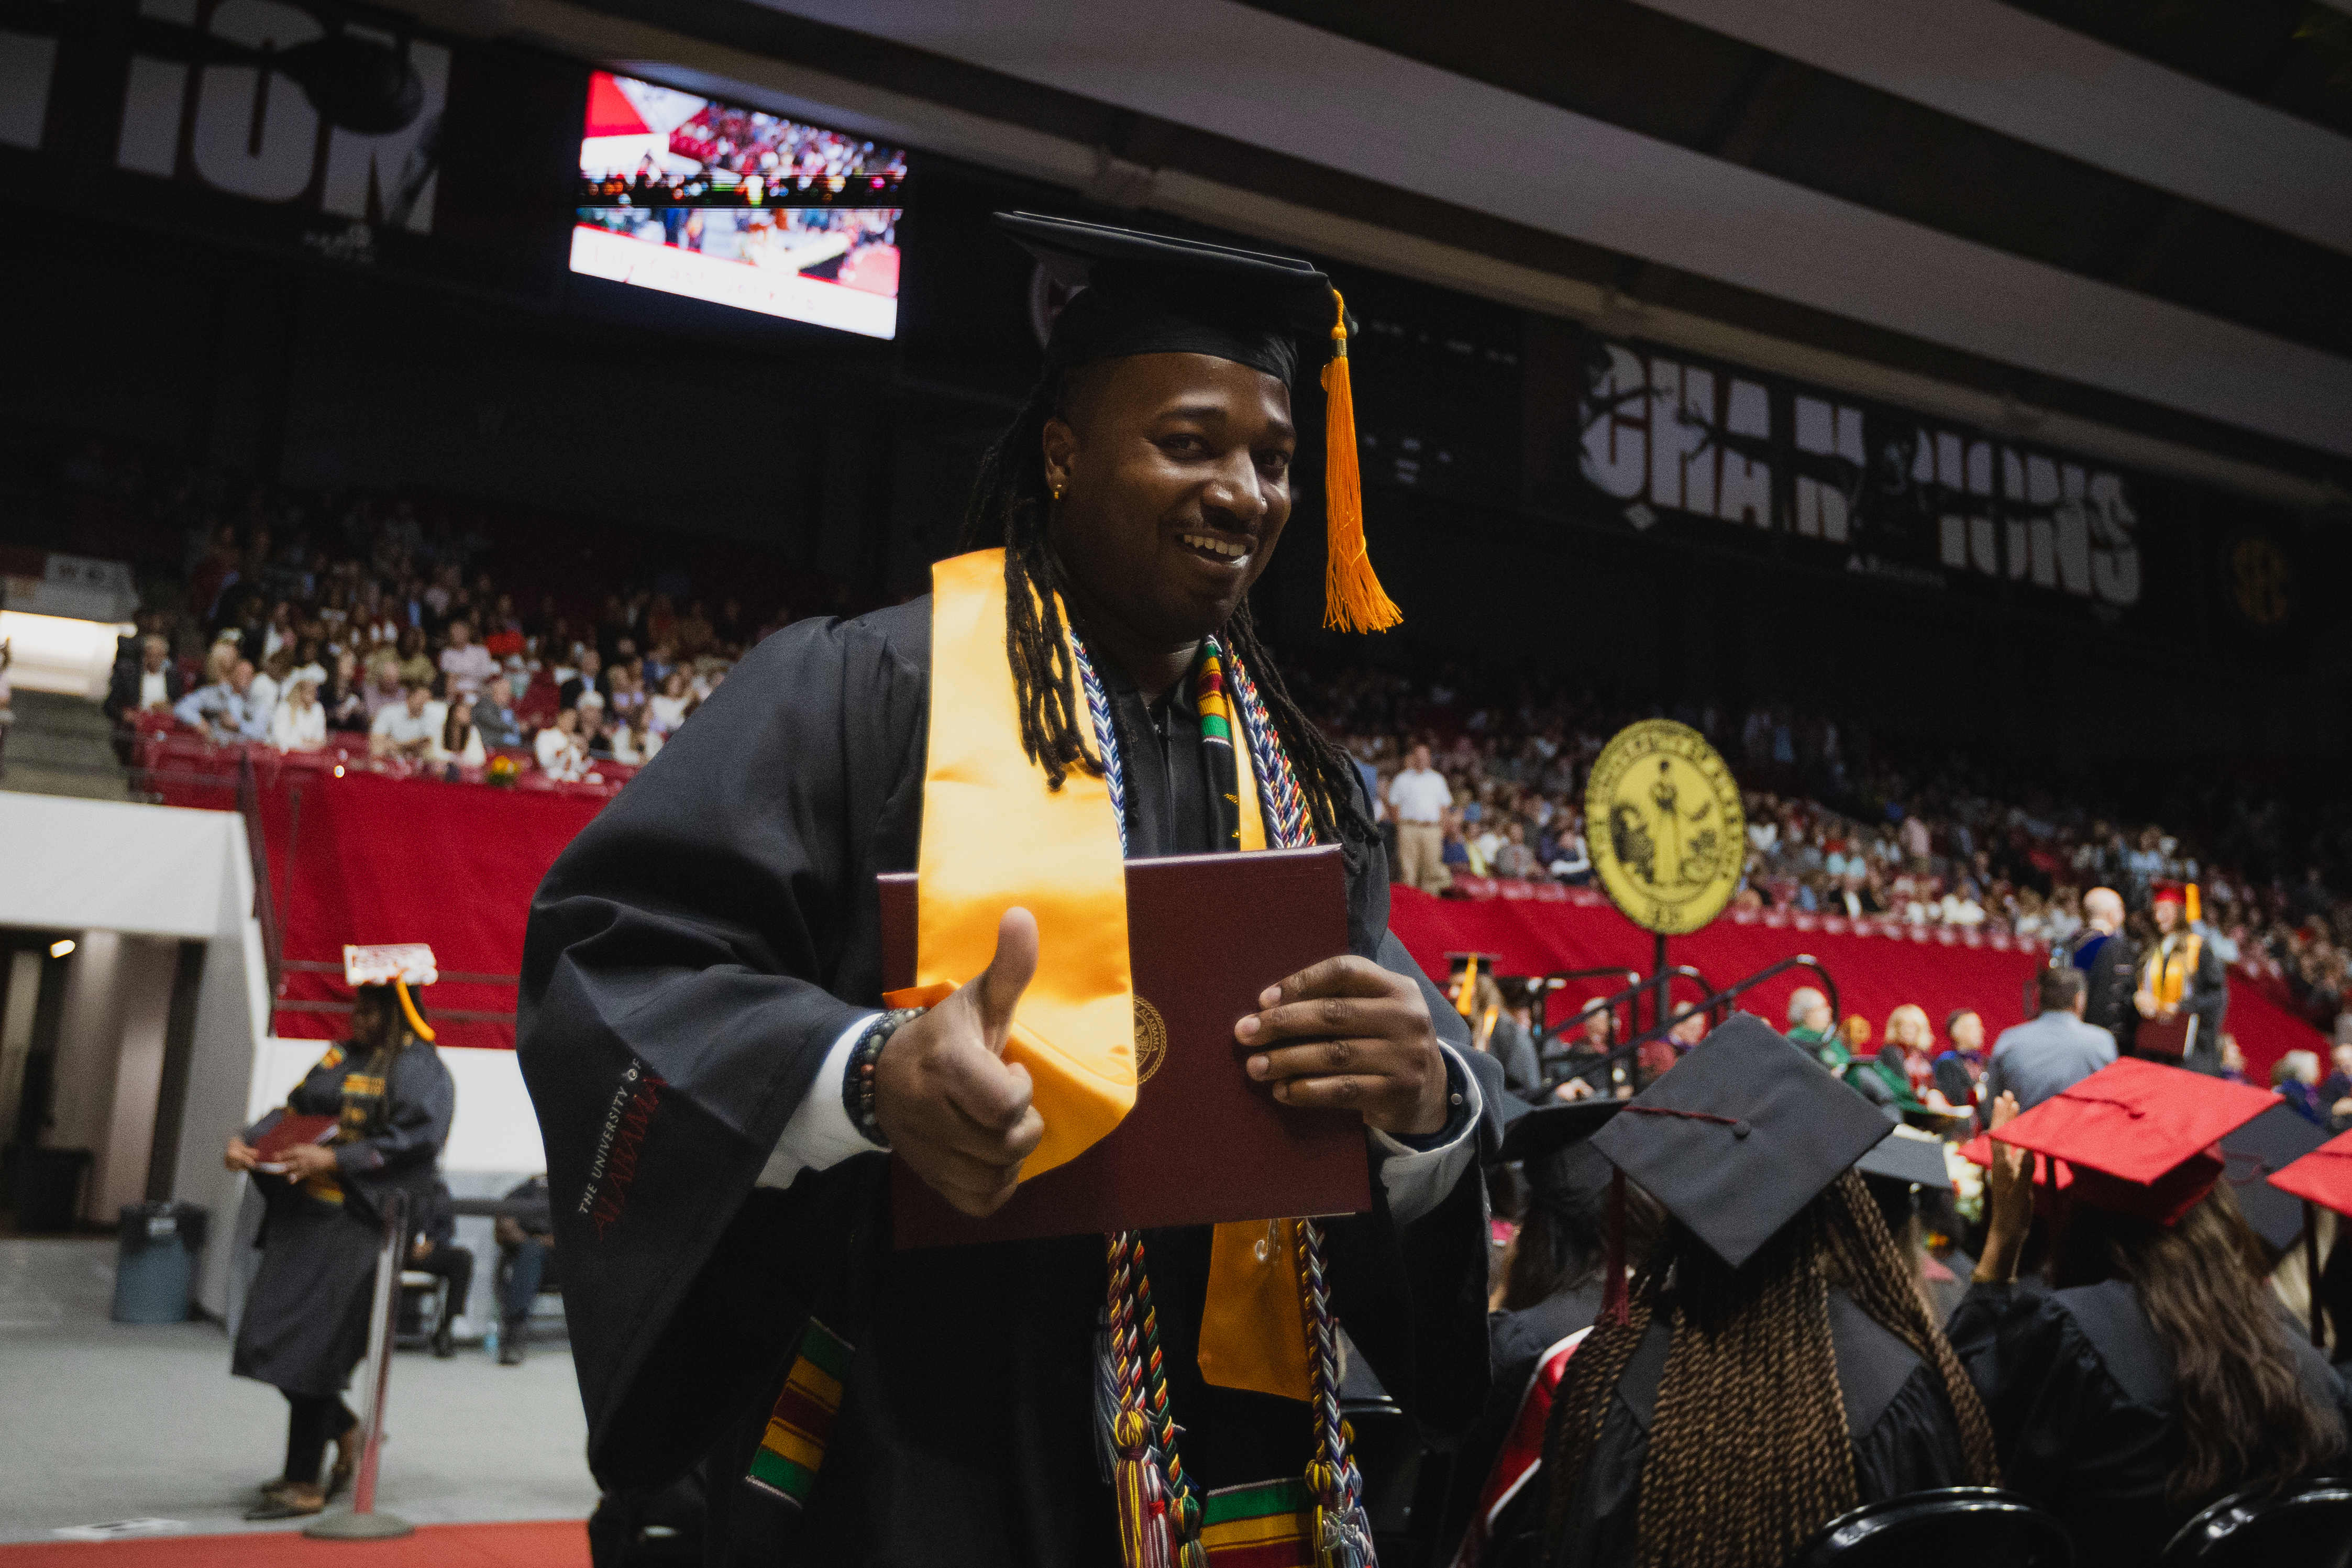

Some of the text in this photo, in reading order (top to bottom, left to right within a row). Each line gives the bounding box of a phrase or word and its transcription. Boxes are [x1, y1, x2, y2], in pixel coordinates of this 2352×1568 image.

[1139, 1009, 1160, 1052] ALABAMA
[578, 1183, 598, 1213] THE
[591, 1086, 628, 1179] UNIVERSITY
